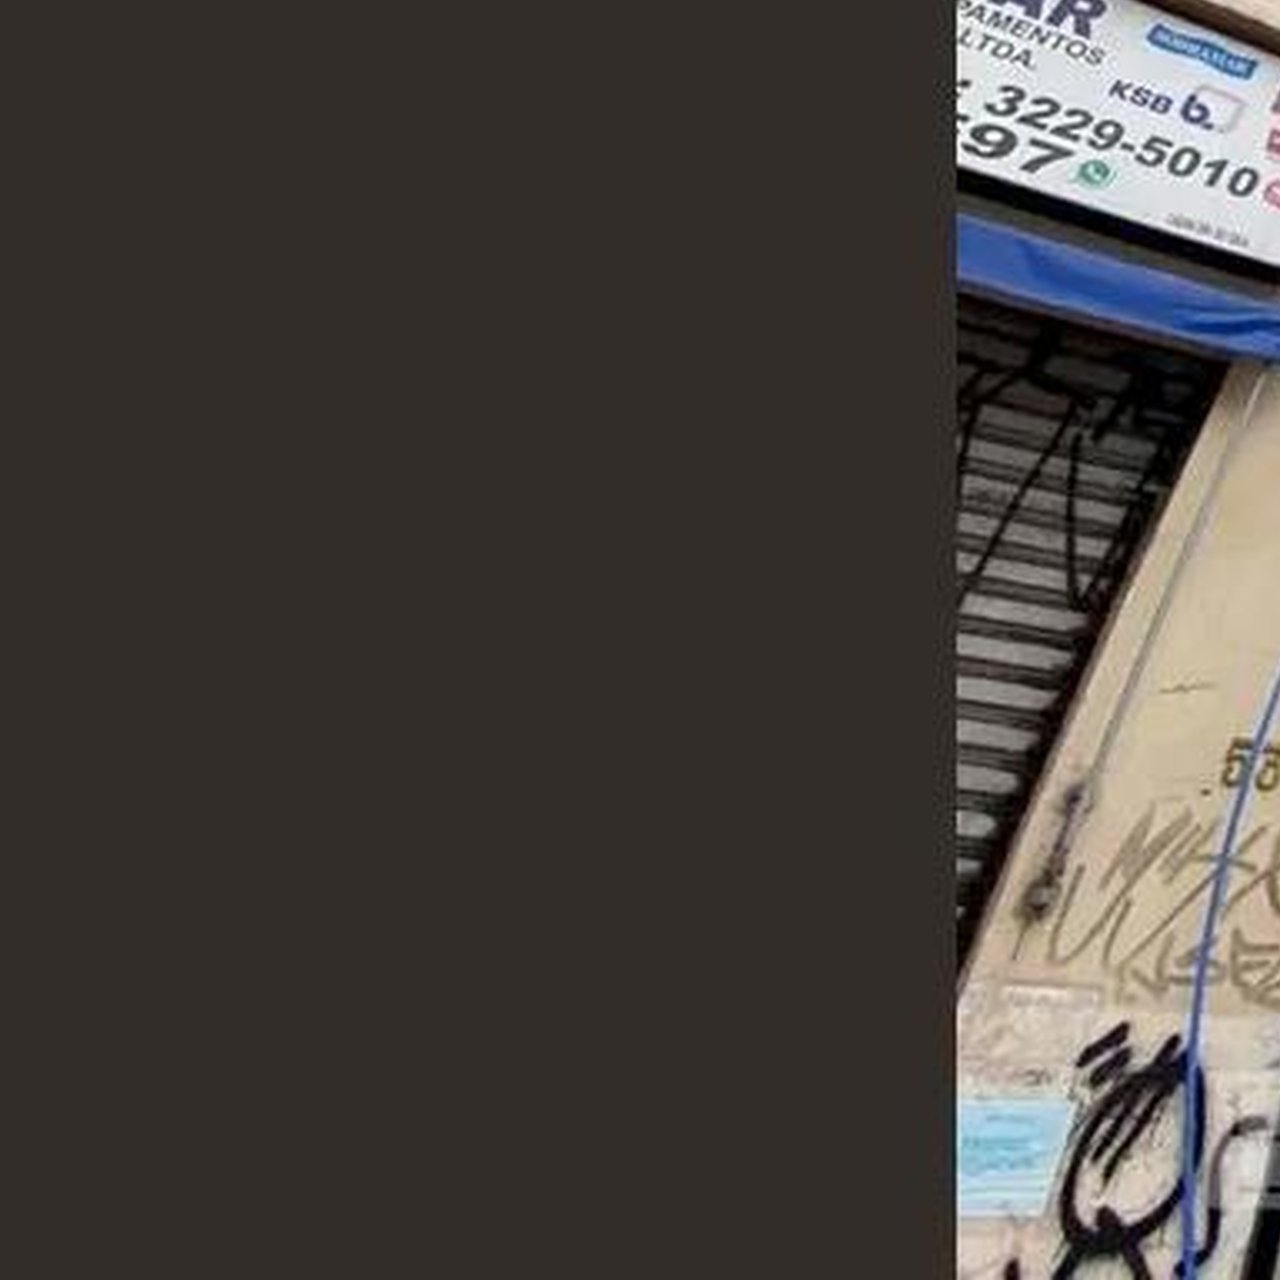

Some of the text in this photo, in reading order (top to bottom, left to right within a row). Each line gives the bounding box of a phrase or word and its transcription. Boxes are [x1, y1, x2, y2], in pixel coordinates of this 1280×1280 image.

[1109, 80, 1175, 115] KSB
[957, 114, 1076, 175] 97
[984, 86, 1261, 198] 3229-5010
